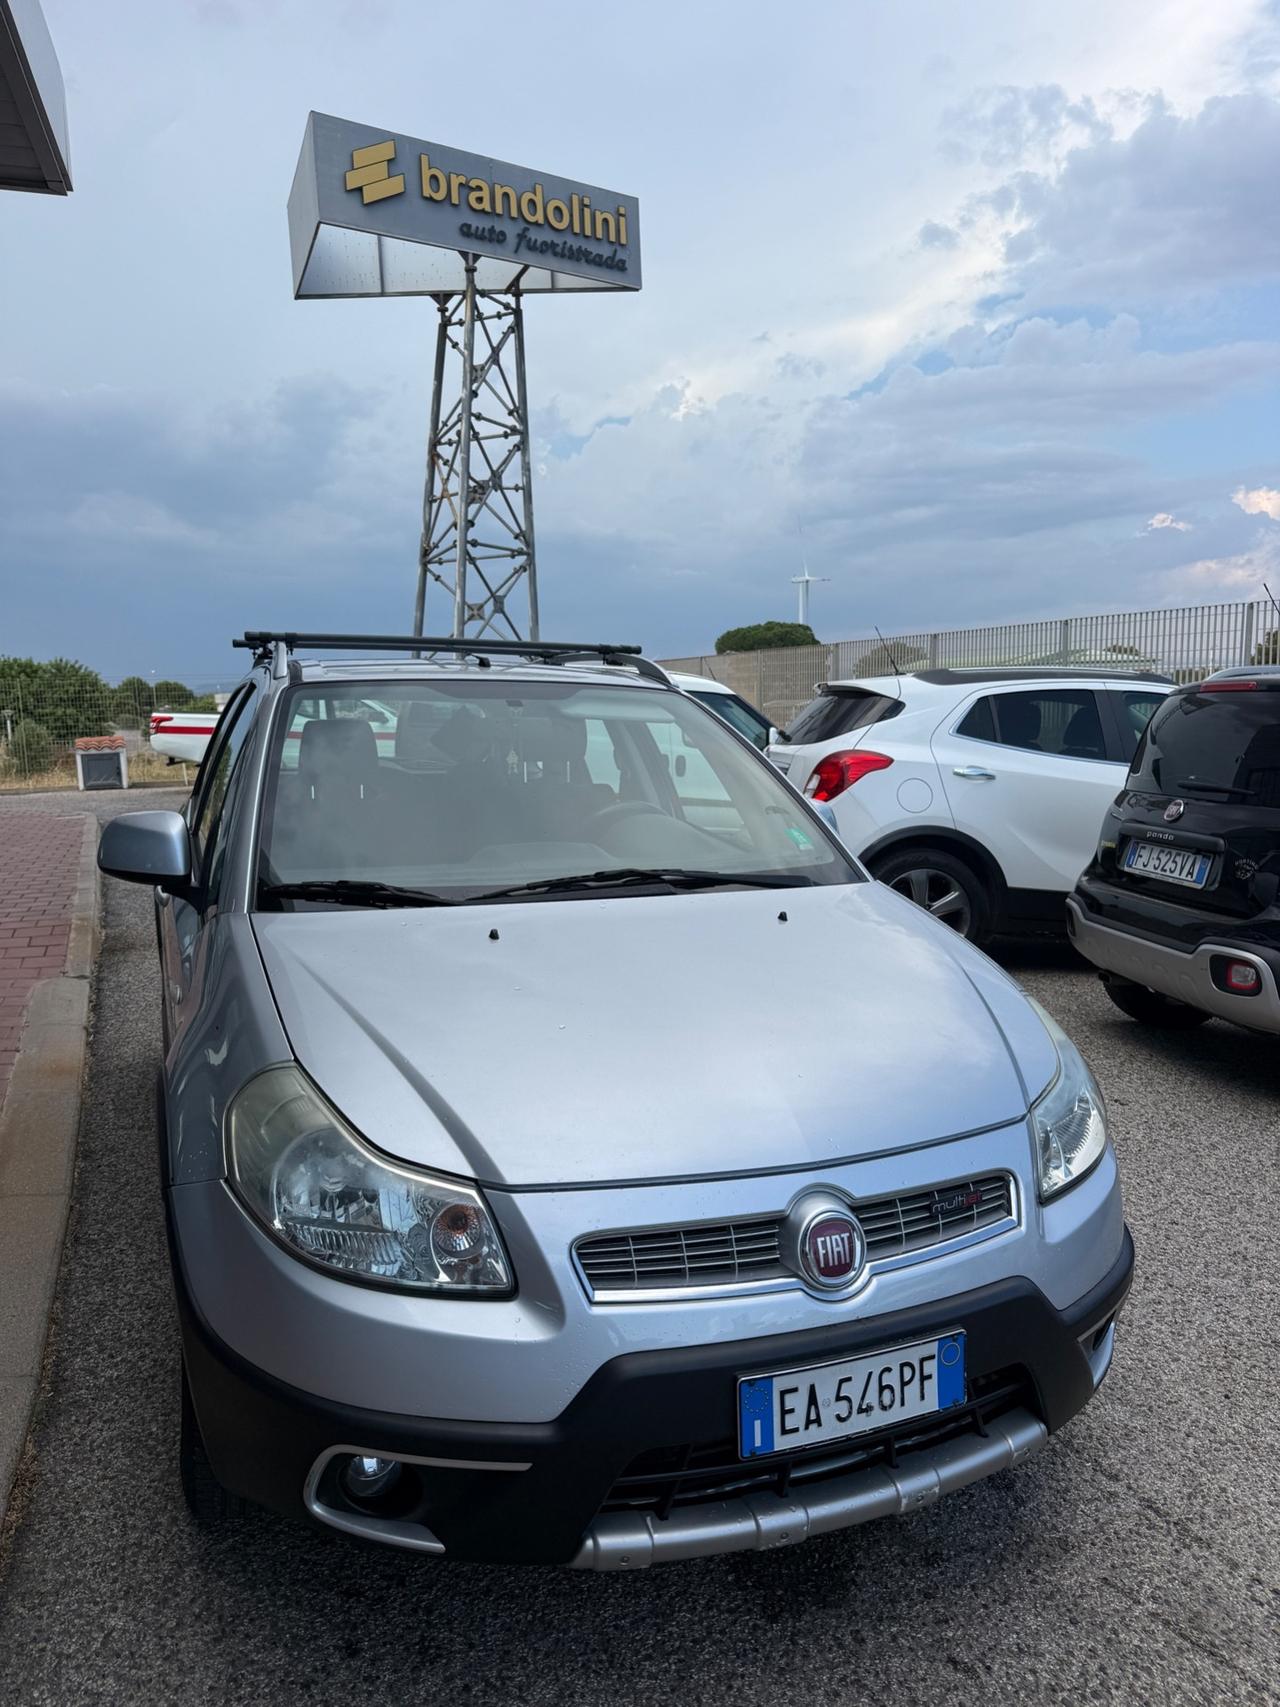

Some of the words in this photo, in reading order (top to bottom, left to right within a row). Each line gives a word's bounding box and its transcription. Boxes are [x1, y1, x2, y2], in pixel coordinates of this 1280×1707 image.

[420, 152, 628, 246] brandolini
[459, 222, 508, 244] auto
[513, 226, 628, 272] fuoristrada
[1146, 831, 1175, 841] panda
[816, 1232, 850, 1269] FIAT
[779, 1383, 823, 1436] EA
[834, 1354, 936, 1423] 546PF
